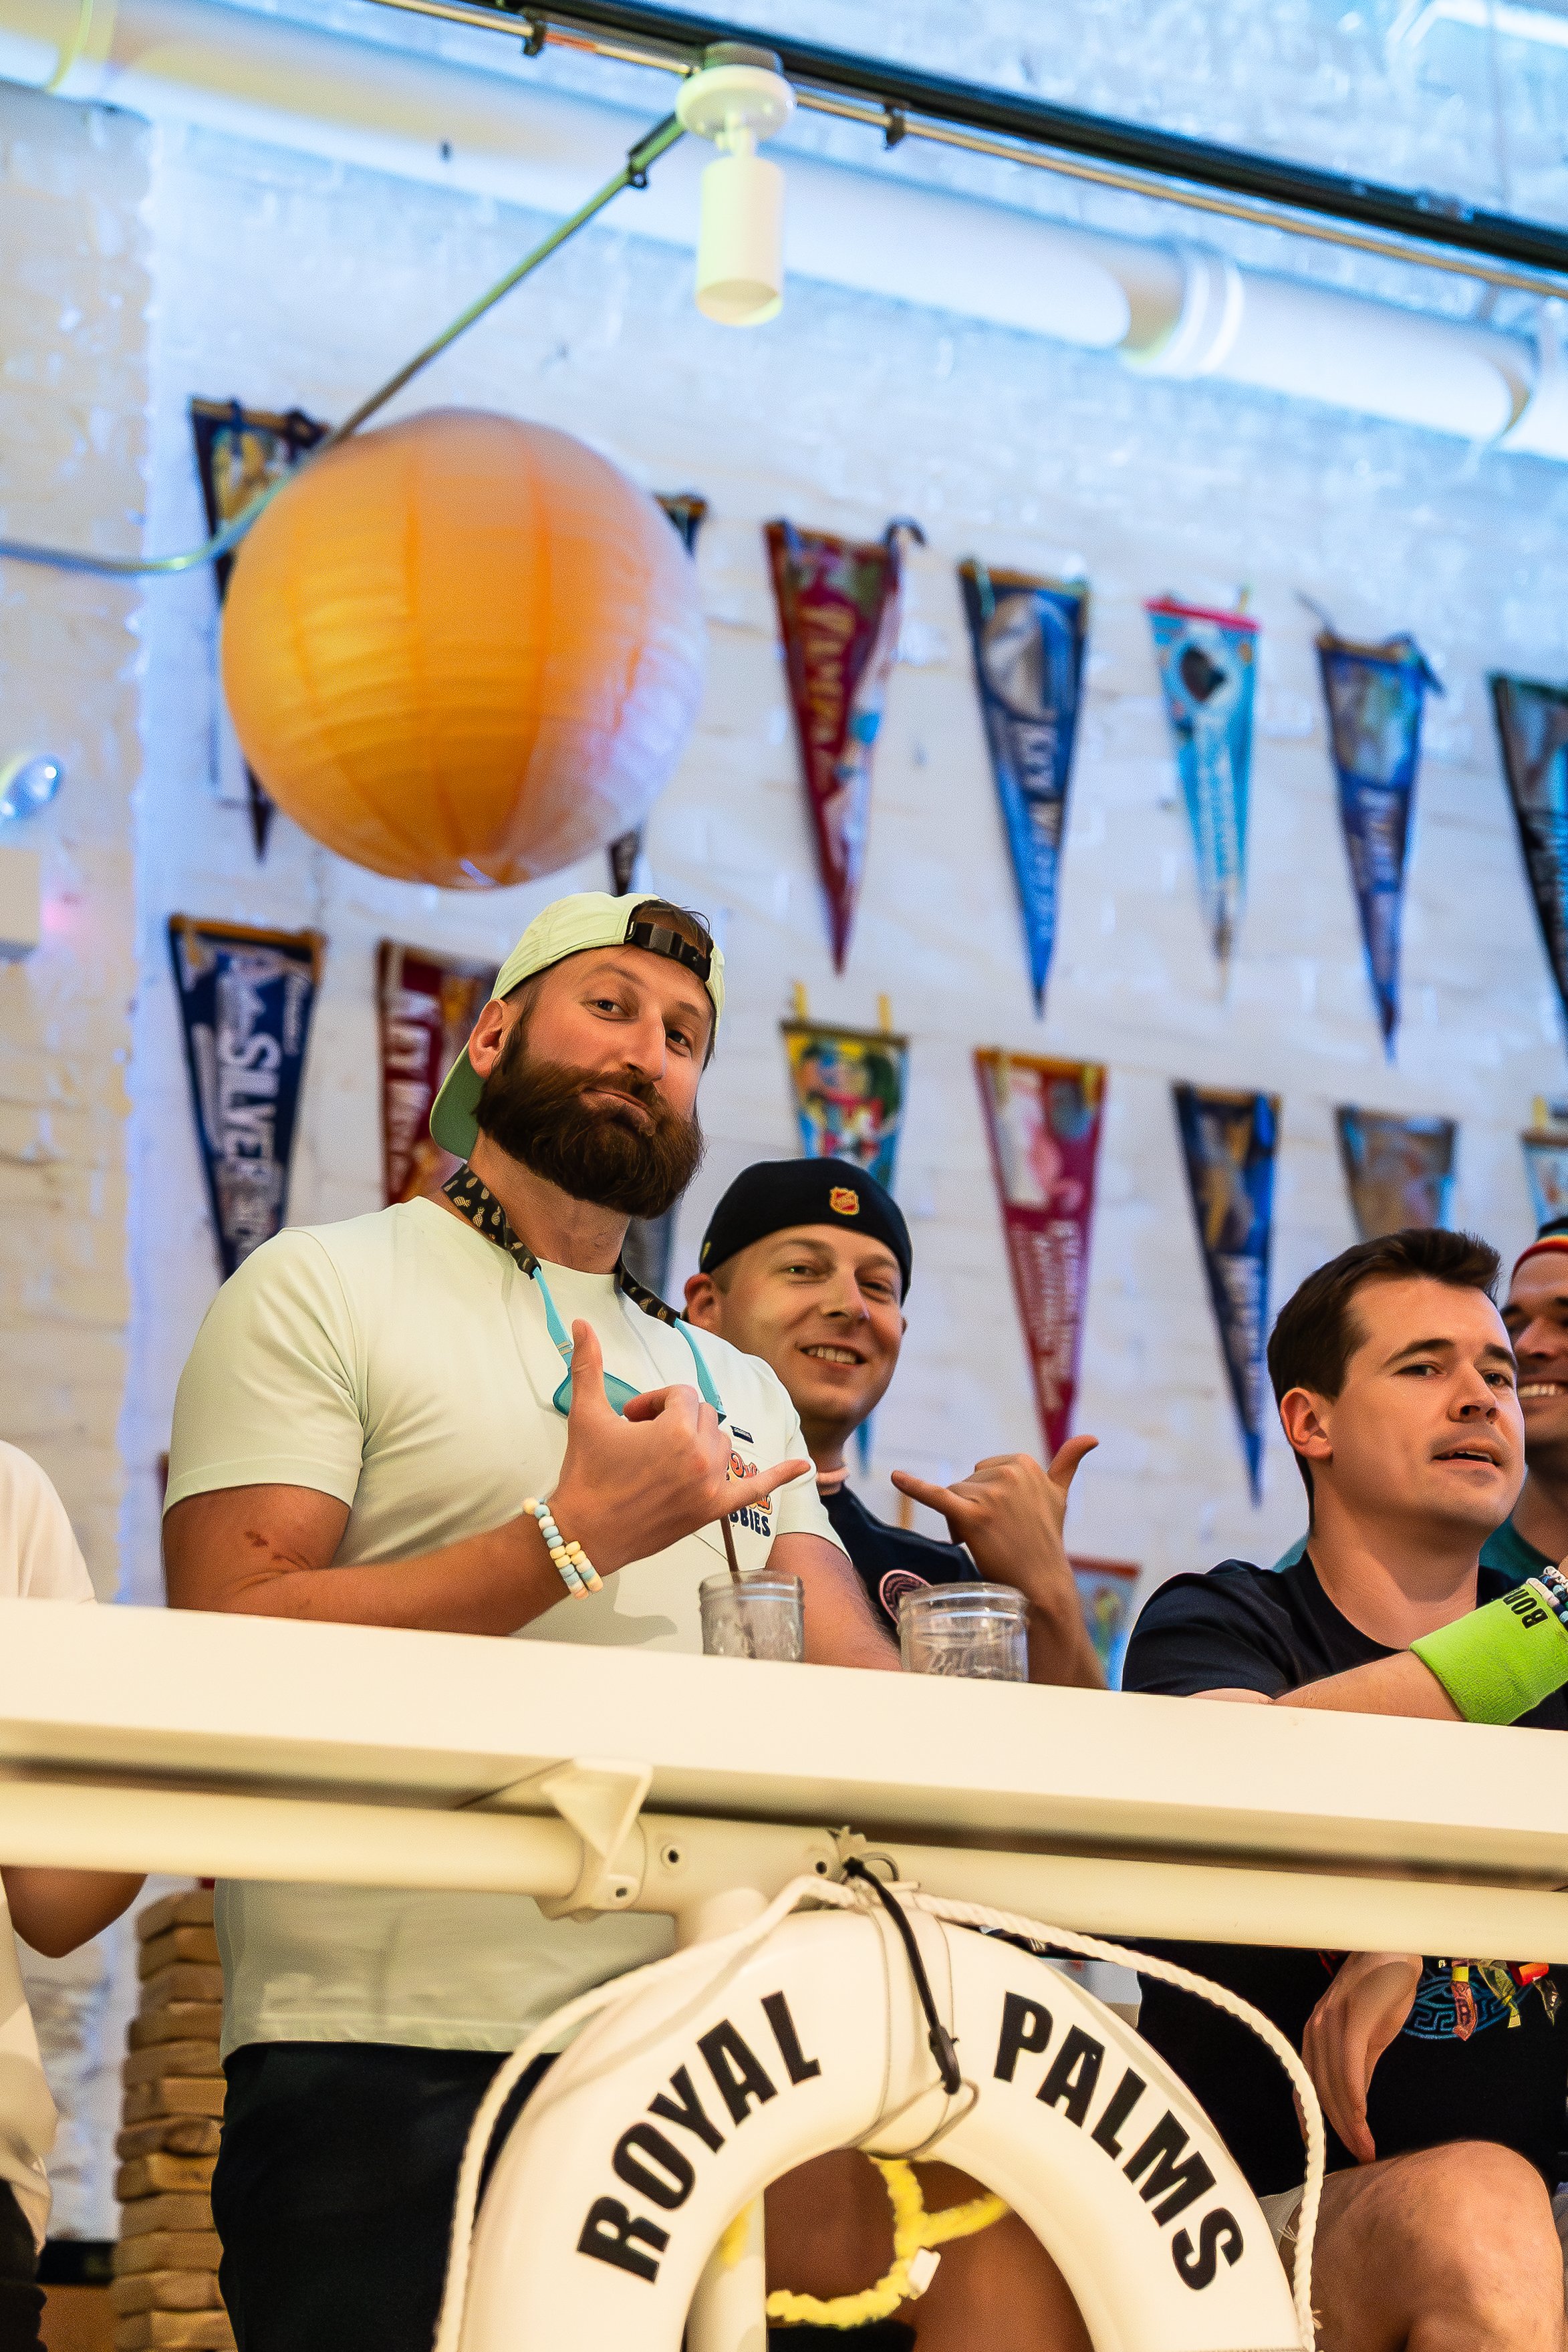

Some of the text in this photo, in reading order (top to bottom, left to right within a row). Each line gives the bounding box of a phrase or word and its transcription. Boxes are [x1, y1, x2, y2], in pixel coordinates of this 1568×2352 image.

[215, 1033, 283, 1184] SILVER
[728, 1507, 772, 1537] BBIES
[577, 1990, 1245, 2291] ROYAL PALMS
